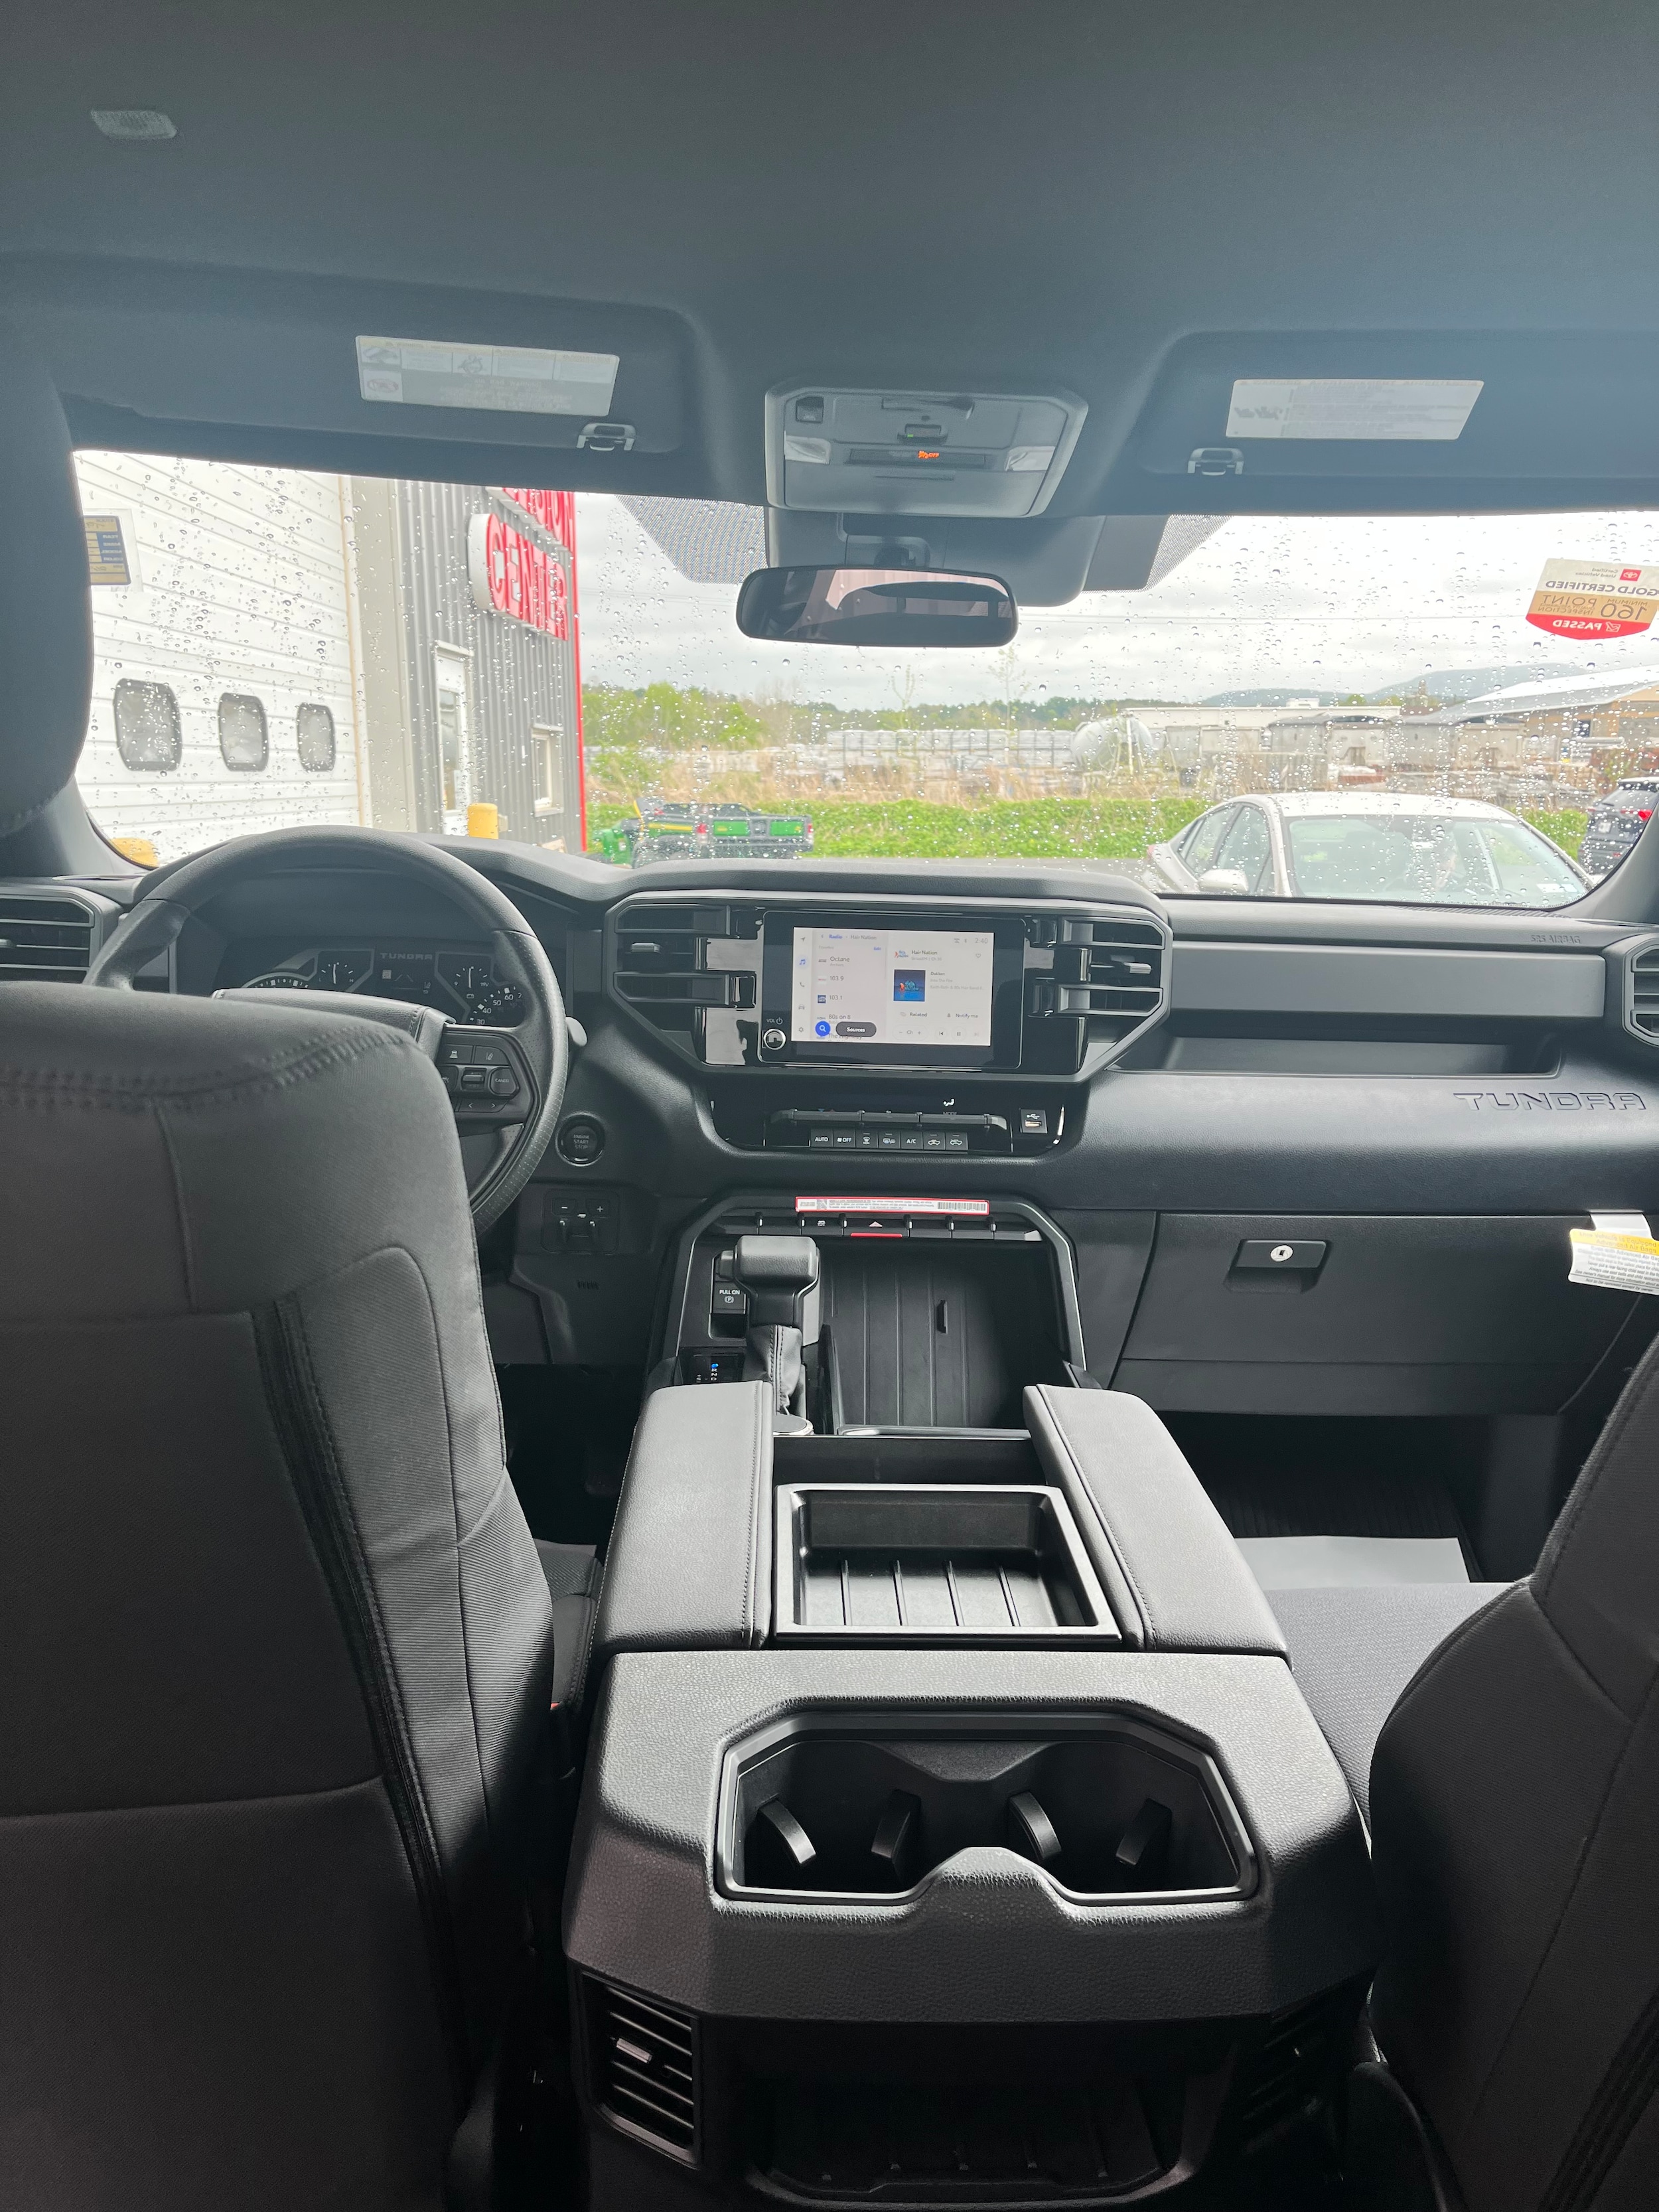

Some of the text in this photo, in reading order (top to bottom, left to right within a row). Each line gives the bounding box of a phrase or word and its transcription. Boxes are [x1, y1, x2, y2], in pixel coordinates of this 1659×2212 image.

[486, 513, 569, 641] CENTER
[1530, 934, 1581, 944] SRS AIRBAG
[1453, 1092, 1646, 1111] TUNDRA
